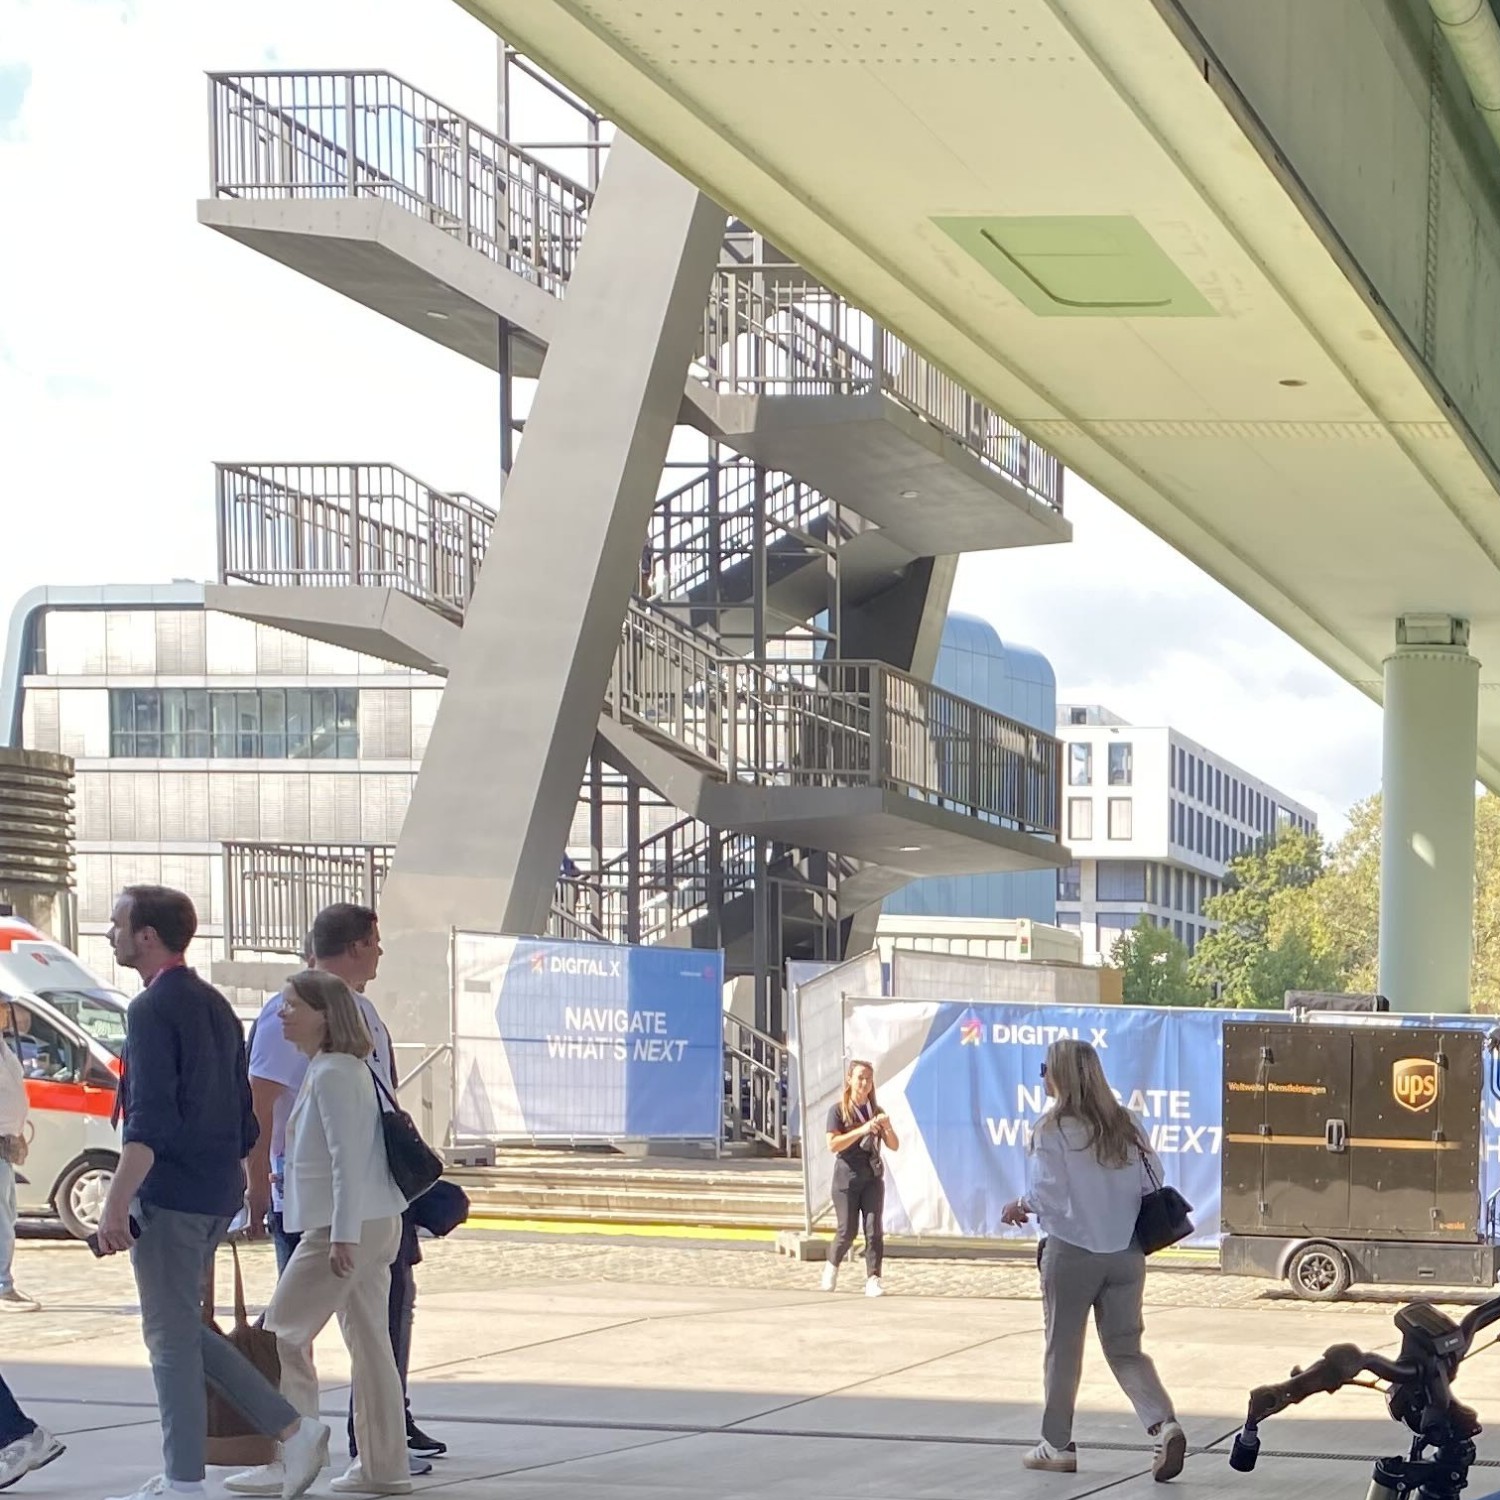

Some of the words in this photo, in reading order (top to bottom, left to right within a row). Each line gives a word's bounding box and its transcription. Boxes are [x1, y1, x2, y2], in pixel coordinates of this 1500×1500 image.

[550, 956, 607, 976] DIGITAL
[610, 960, 620, 977] X
[565, 1006, 668, 1035] NAVIGATE
[547, 1035, 628, 1061] WHAT'S
[633, 1038, 688, 1062] NEXT
[1090, 1027, 1108, 1049] X
[1397, 1074, 1434, 1104] ups
[1150, 1124, 1222, 1155] EXT
